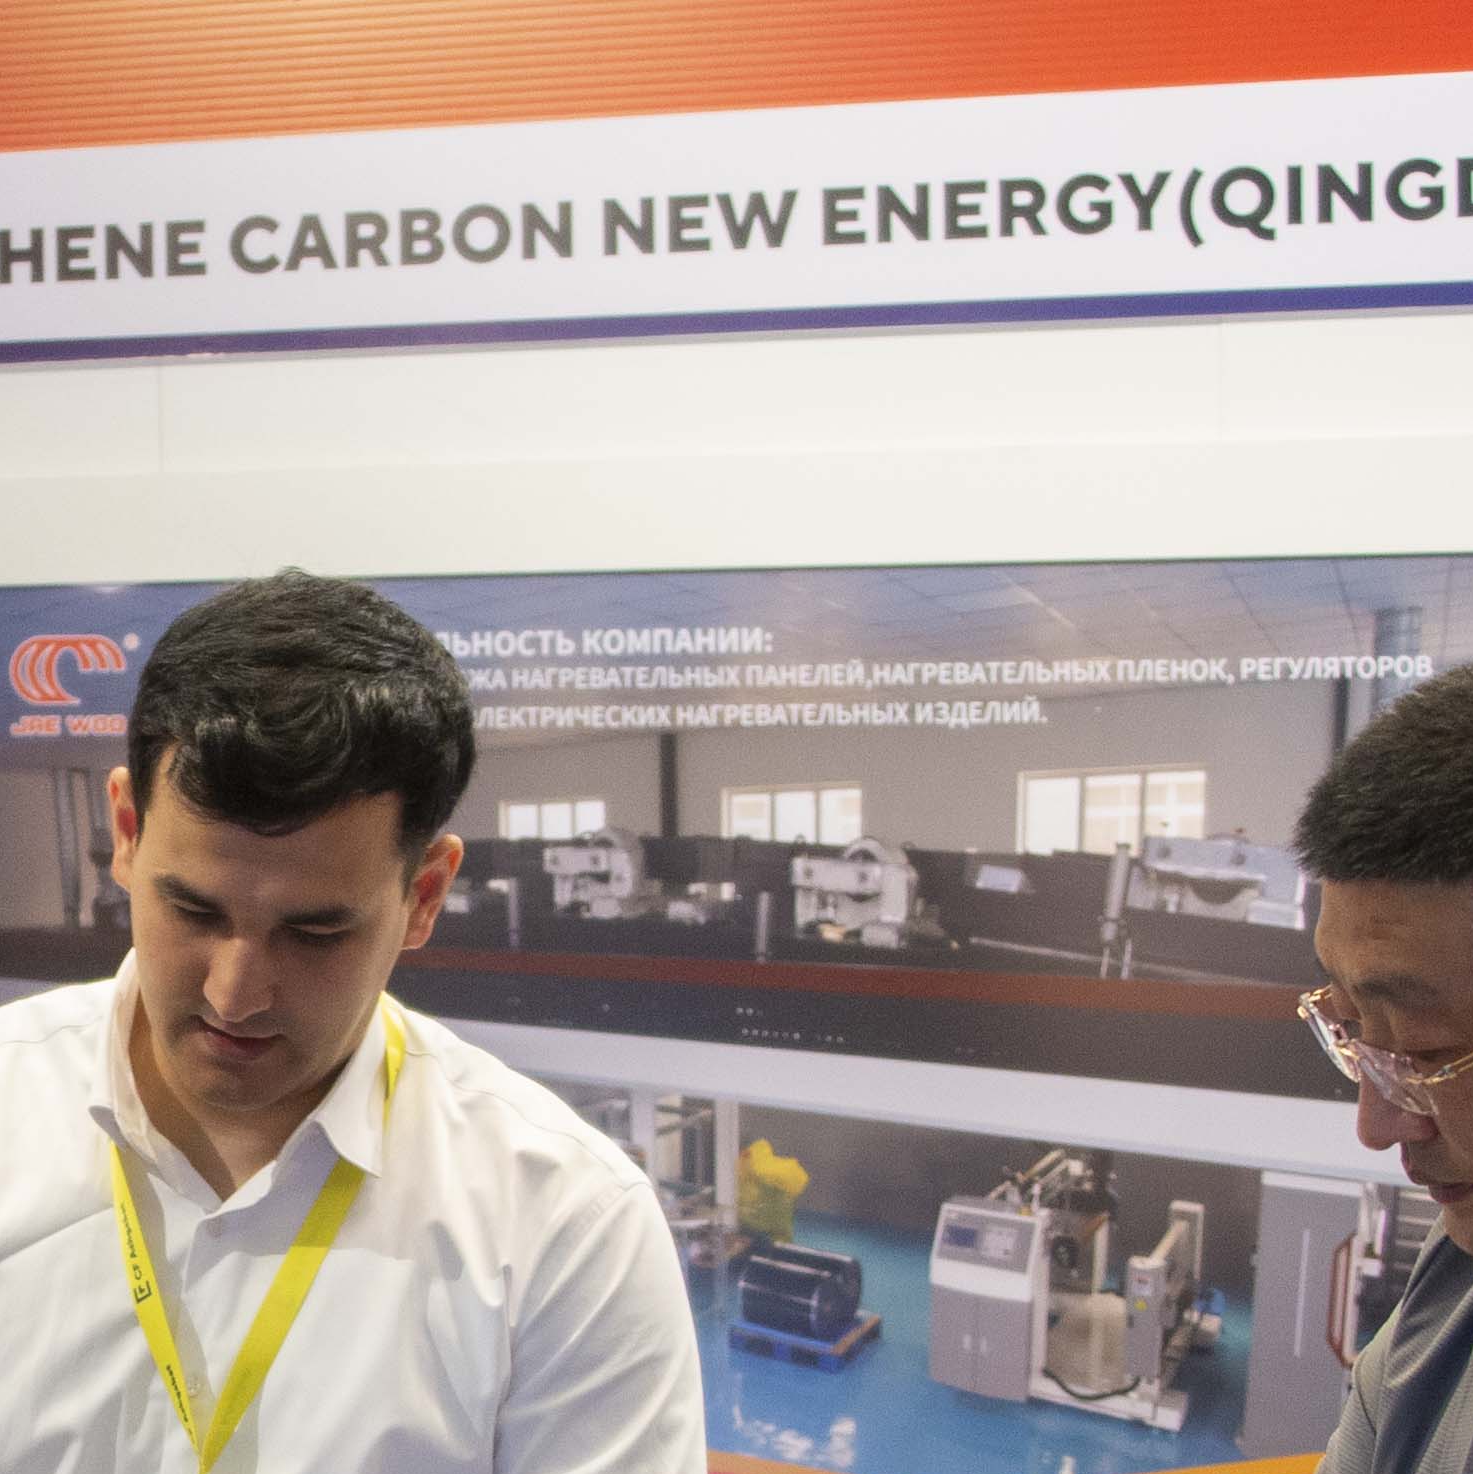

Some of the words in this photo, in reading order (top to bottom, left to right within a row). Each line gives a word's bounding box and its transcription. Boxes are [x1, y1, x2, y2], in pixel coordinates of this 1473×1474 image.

[228, 201, 574, 275] CARBON
[603, 190, 799, 256] NEW
[582, 627, 773, 656] КОМПАНИИ:
[511, 664, 741, 690] НАГРЕВАТЕЛЬНЫХ
[1117, 657, 1235, 686] ПЛЕНОК,
[1239, 654, 1434, 681] РЕГУЛЯТОРОВ
[472, 703, 672, 730] ЛЕКТРИЧЕСКИХ
[677, 701, 909, 728] НАГРЕВАТЕЛЬНЫХ
[914, 695, 1048, 729] ИЗДЕЛИЙ.
